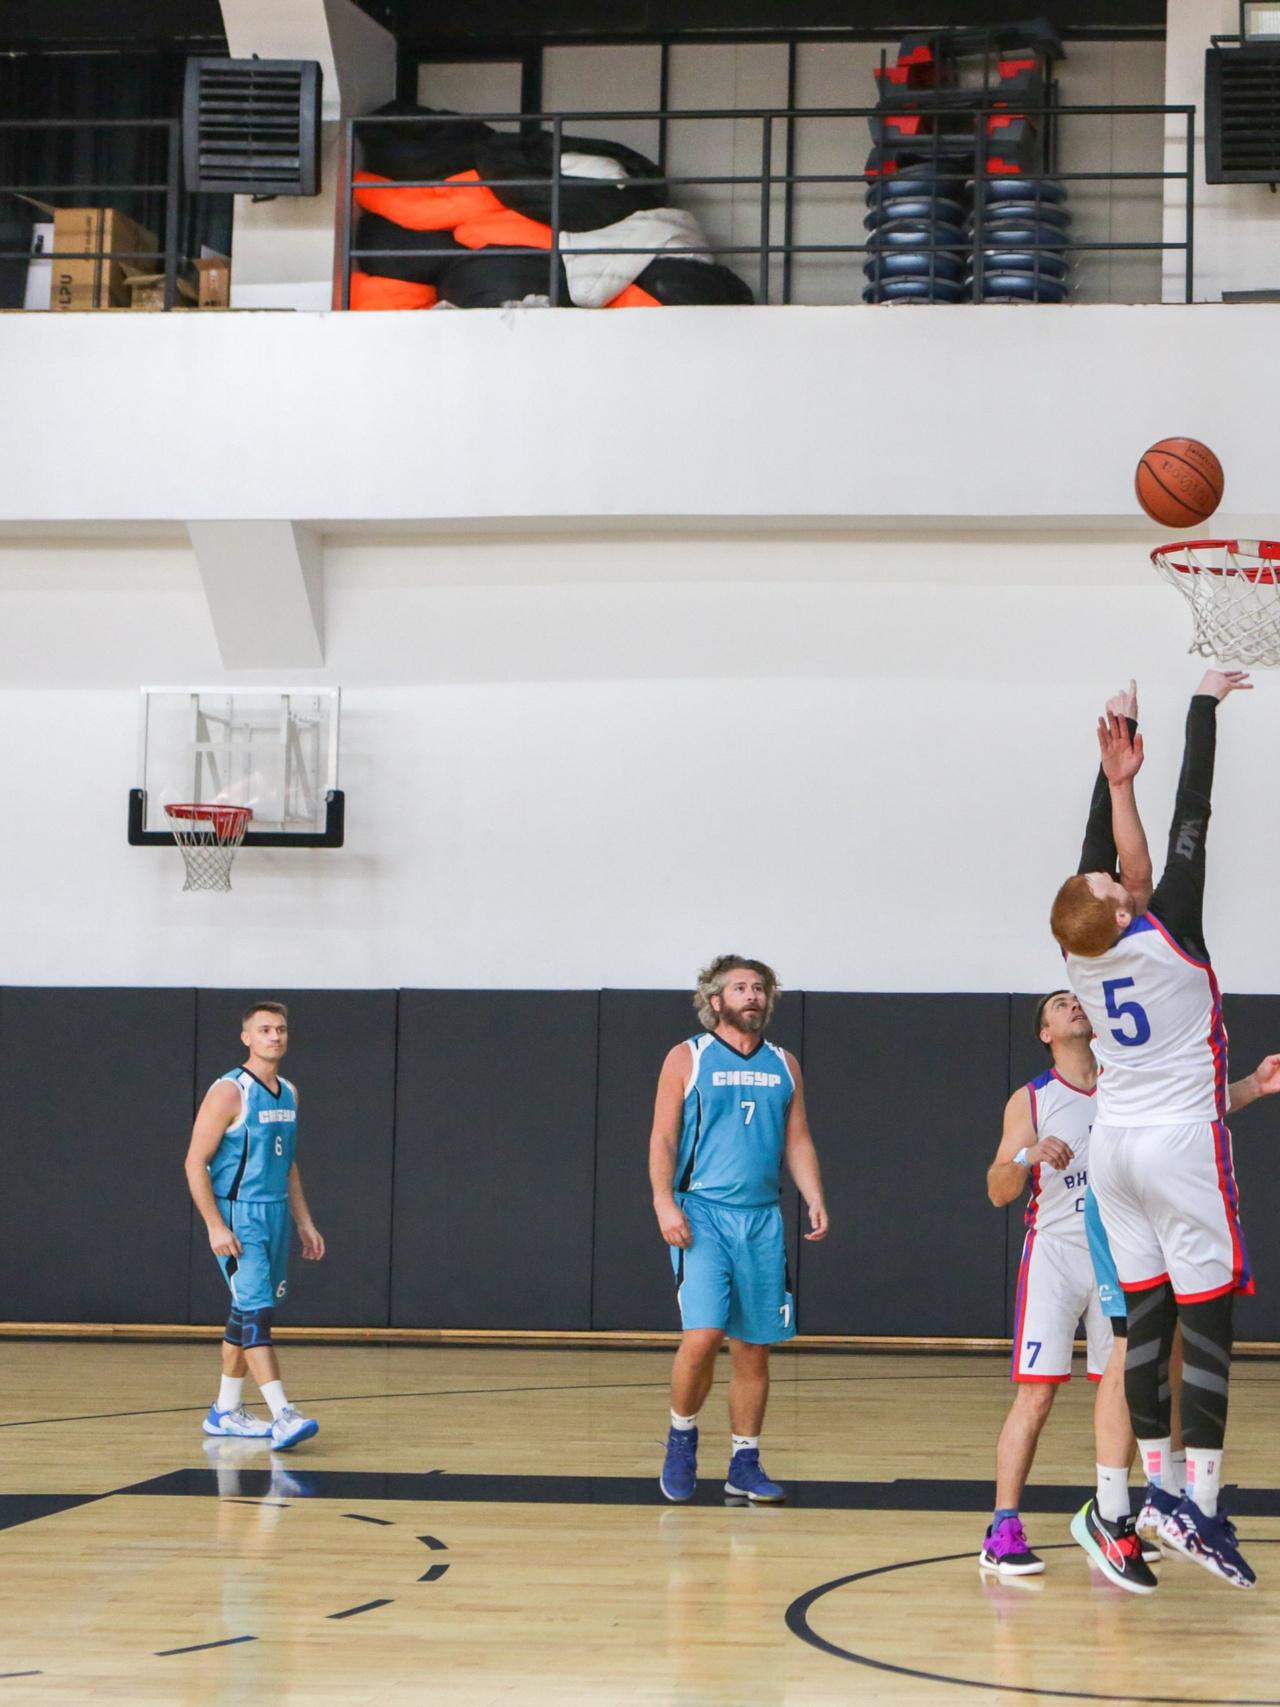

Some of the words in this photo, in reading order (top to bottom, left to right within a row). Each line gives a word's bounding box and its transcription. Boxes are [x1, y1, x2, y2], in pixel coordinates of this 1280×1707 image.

[1102, 976, 1151, 1047] 5
[712, 1071, 781, 1087] СИБУР
[258, 1109, 296, 1124] СИБУР
[740, 1101, 756, 1125] 7
[275, 1135, 283, 1156] 6
[276, 1280, 286, 1297] 6
[1026, 1341, 1042, 1368] 7
